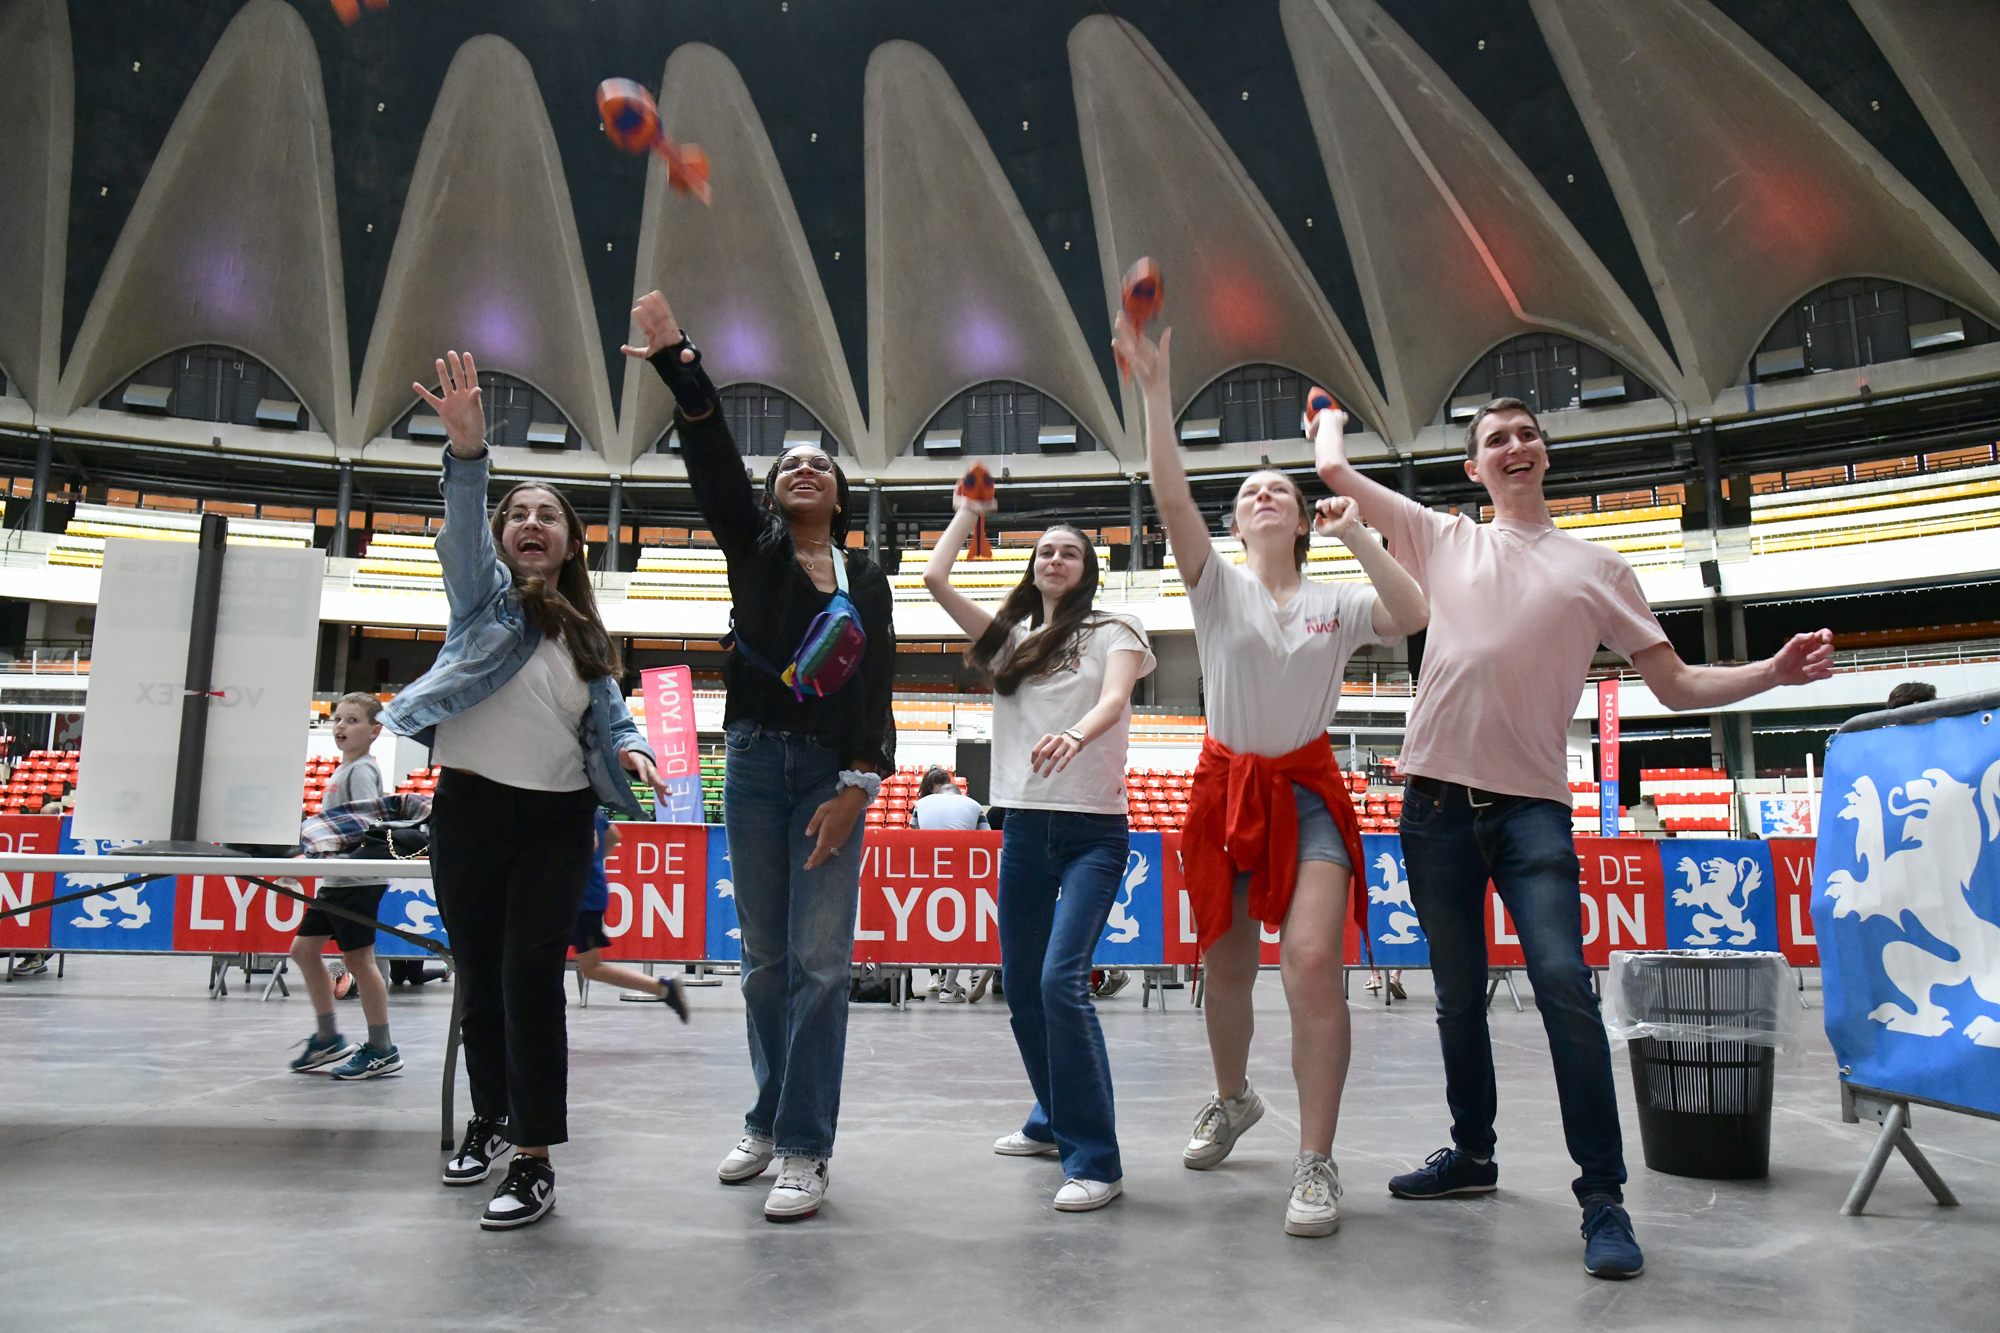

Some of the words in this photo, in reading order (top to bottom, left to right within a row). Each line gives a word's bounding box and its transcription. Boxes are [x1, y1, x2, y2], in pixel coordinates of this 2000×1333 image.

[1605, 693, 1614, 744] LYON
[1605, 751, 1614, 777] DE
[637, 842, 685, 874] DE
[969, 848, 1003, 878] D
[1599, 855, 1645, 885] DE
[190, 877, 324, 932] LYO
